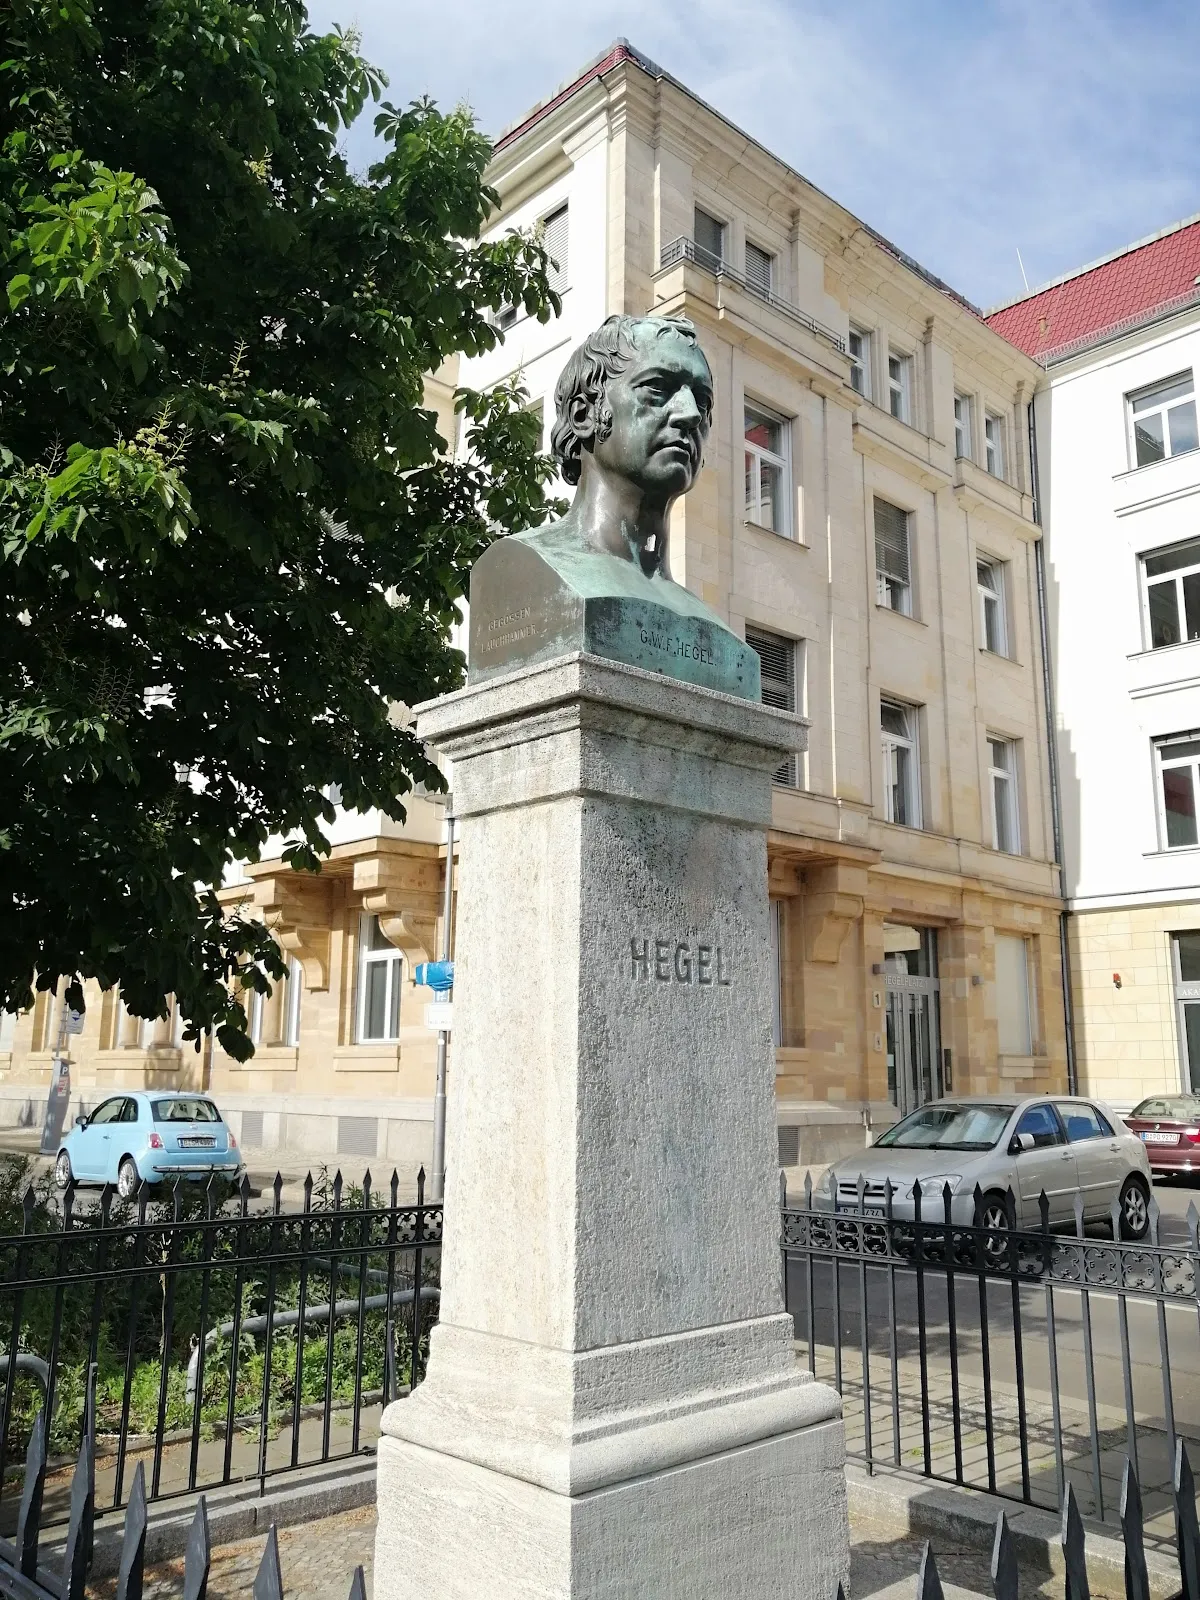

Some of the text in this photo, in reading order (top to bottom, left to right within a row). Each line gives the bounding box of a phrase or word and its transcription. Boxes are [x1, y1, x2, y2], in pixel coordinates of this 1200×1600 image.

[488, 606, 531, 631] GEGOSSEN
[630, 937, 731, 986] HEGEL
[1181, 988, 1200, 996] AKA
